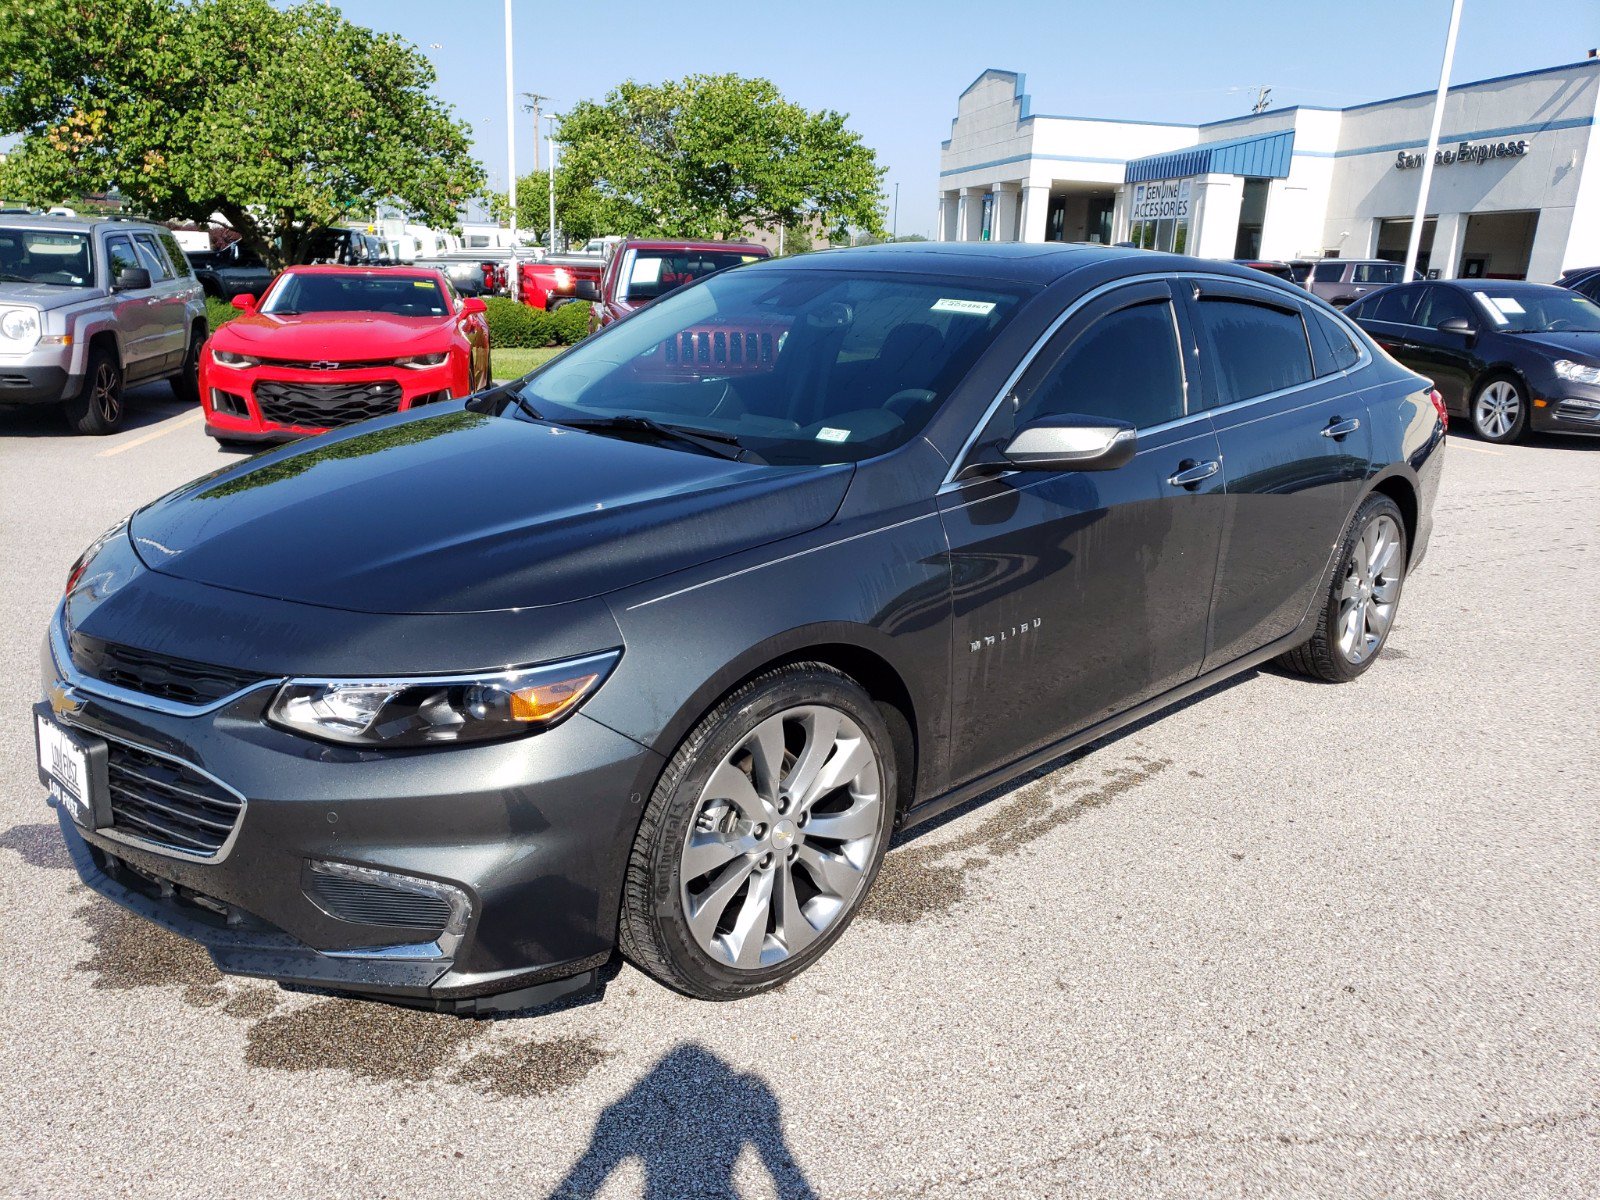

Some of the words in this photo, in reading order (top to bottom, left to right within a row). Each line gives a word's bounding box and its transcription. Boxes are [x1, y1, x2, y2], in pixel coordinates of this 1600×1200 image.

[1395, 150, 1456, 169] Servce
[1457, 140, 1528, 165] Express
[1146, 184, 1178, 200] GENUINE
[1134, 200, 1188, 218] ACCESSORES
[969, 617, 1042, 653] MALIBU
